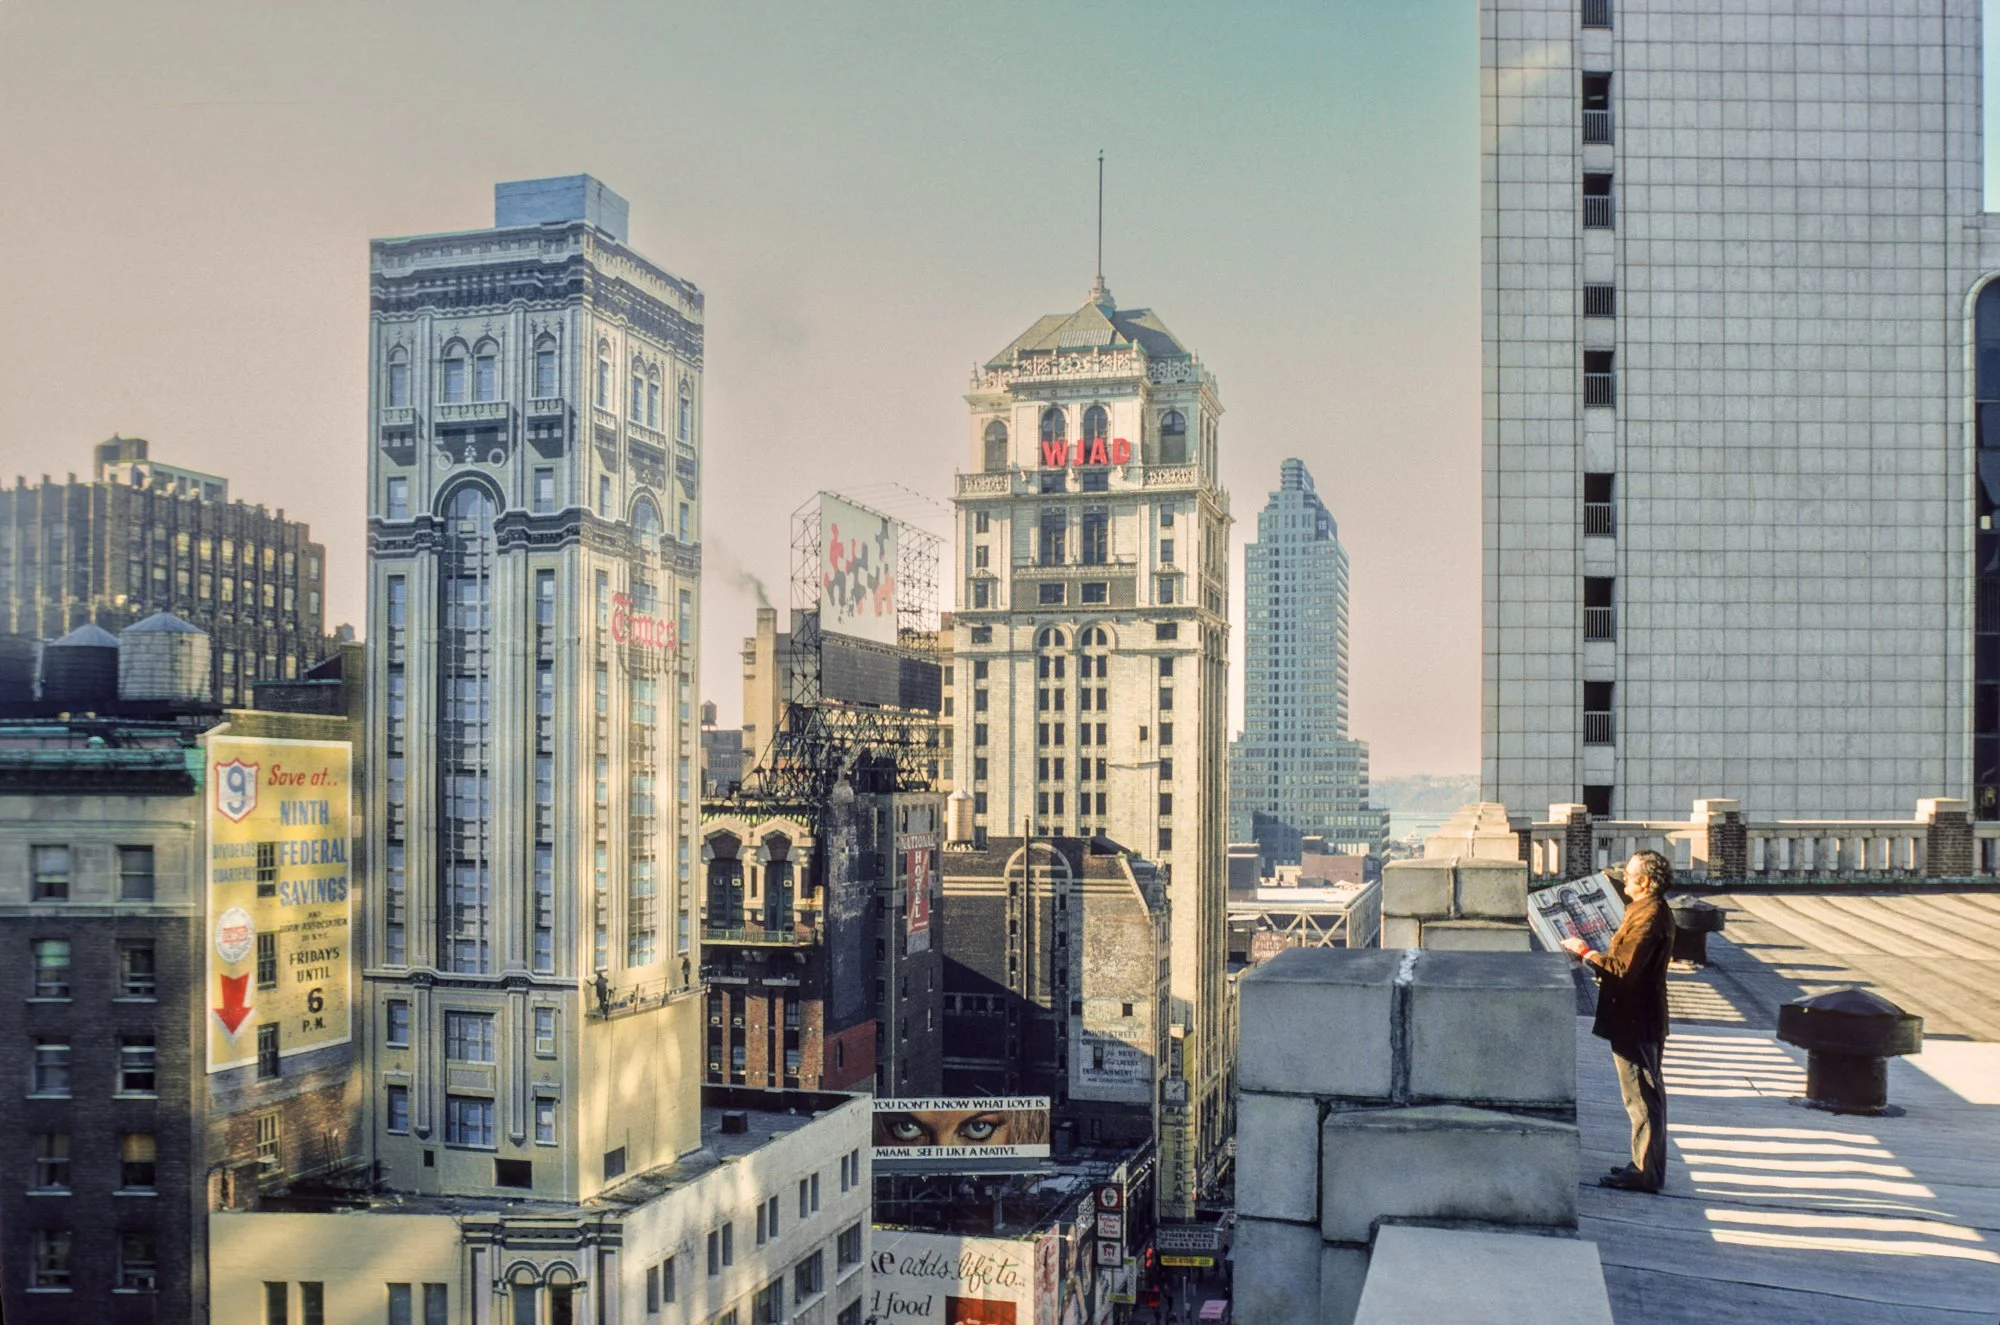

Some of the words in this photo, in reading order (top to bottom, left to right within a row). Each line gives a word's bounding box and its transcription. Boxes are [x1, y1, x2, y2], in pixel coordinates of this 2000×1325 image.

[1042, 436, 1131, 468] WJAD
[268, 764, 306, 786] Save
[227, 765, 246, 815] 9
[281, 800, 329, 825] NINTH
[280, 838, 348, 866] FEDERAL
[901, 834, 936, 850] NATIONAL
[280, 877, 348, 907] SAVINGS
[914, 850, 922, 919] HOTEL
[290, 947, 340, 966] FRIDAYS
[297, 967, 331, 983] UNTIL
[307, 987, 324, 1013] 6
[302, 1017, 326, 1033] P.M.
[873, 1100, 895, 1110] YOU
[898, 1099, 929, 1110] DON'T
[934, 1100, 969, 1109] KNOW
[974, 1100, 1004, 1109] WHAT
[1007, 1099, 1031, 1108] LOVE
[1035, 1099, 1047, 1108] IS.
[917, 1148, 932, 1157] SEE
[935, 1148, 943, 1156] IT
[946, 1148, 966, 1156] LIKE
[969, 1148, 977, 1156] A
[979, 1147, 1018, 1156] NATIVE.
[900, 1249, 951, 1279] adds
[957, 1252, 993, 1293] life
[884, 1292, 933, 1320] food
